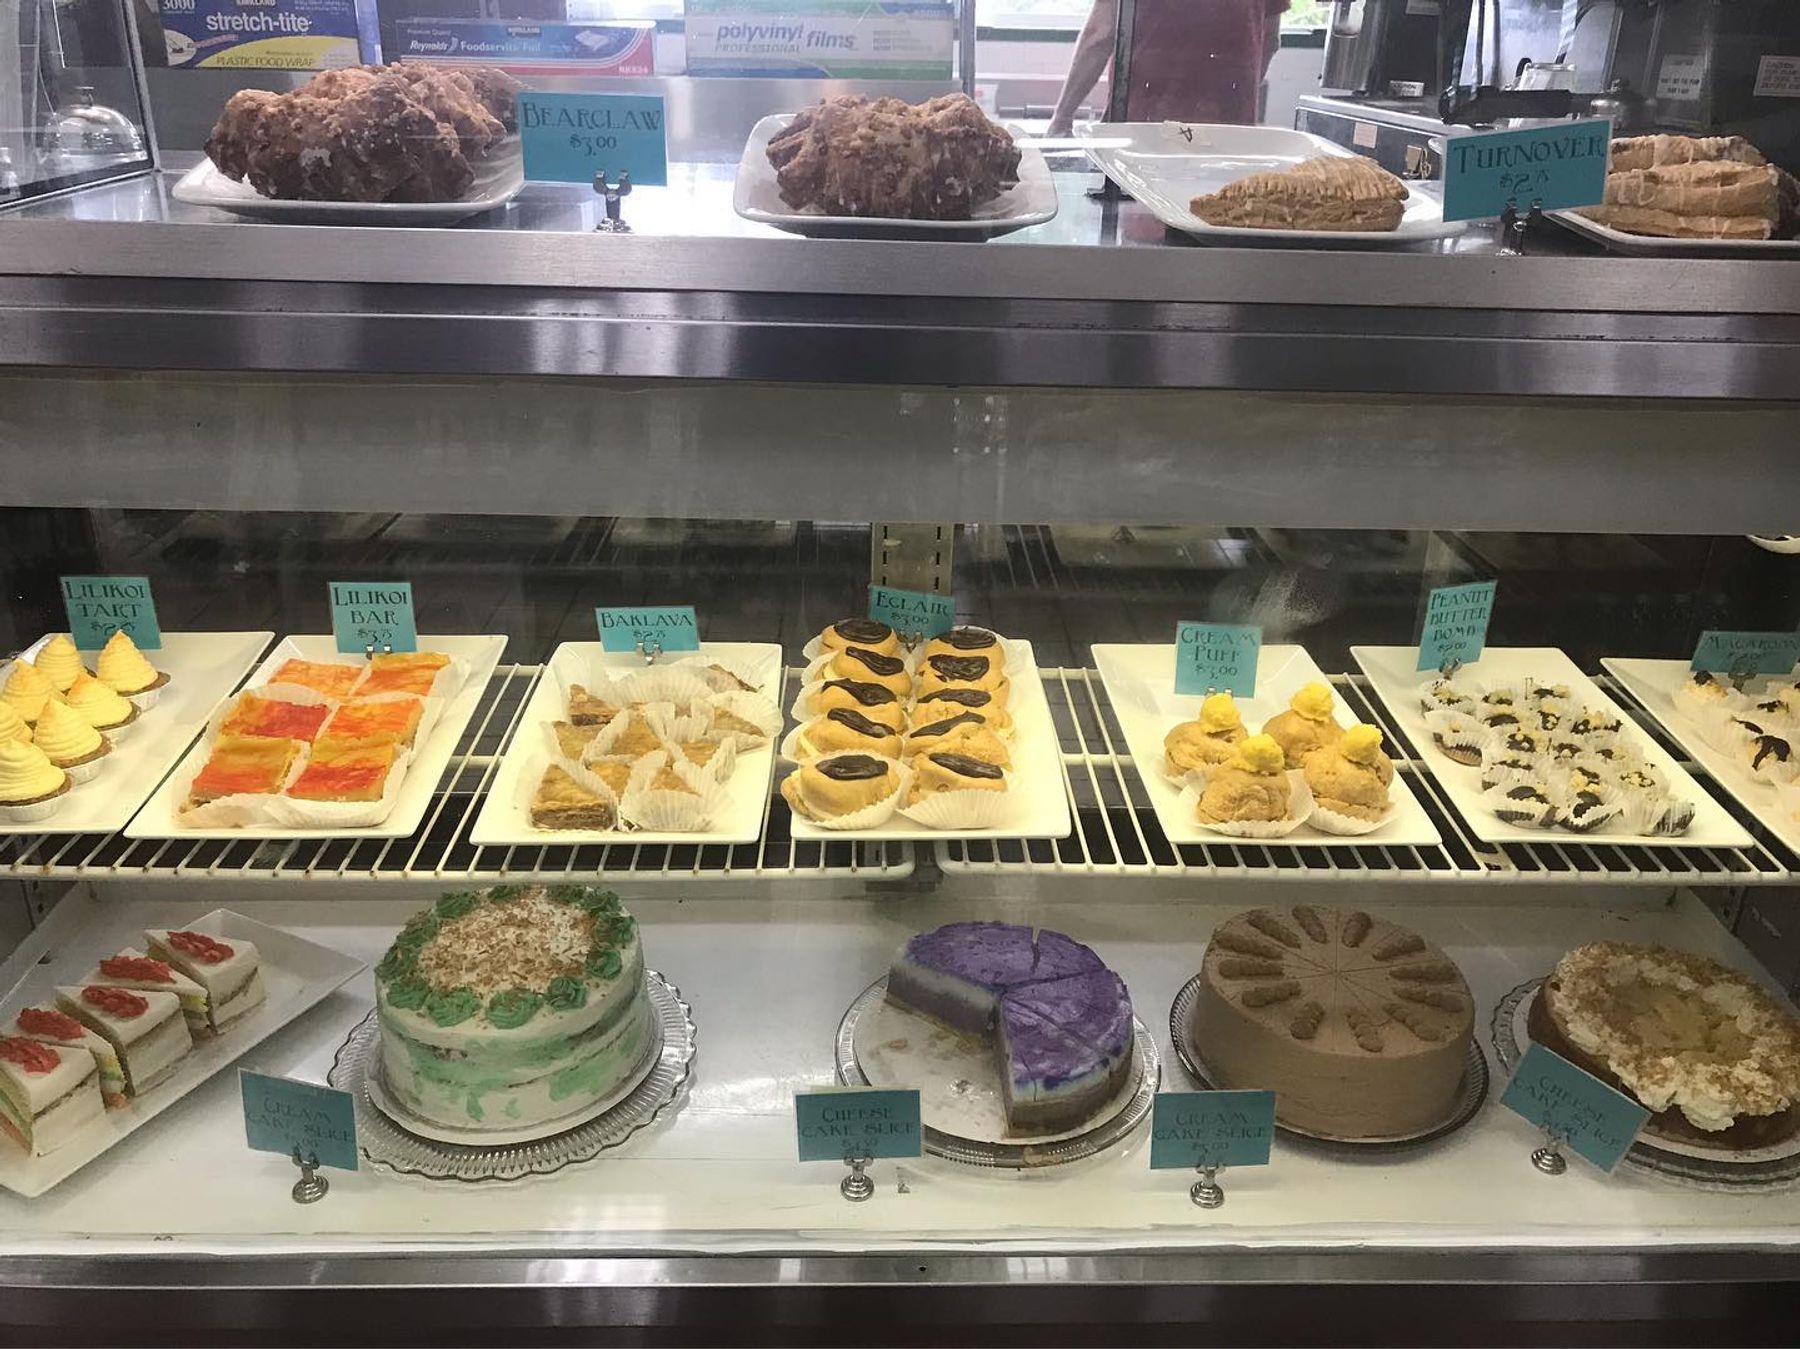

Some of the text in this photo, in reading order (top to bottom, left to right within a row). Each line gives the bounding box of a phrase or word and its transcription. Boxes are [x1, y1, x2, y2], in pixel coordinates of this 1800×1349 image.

[206, 11, 310, 33] stretch-tite
[716, 22, 804, 43] polyvinyl
[805, 30, 857, 50] films
[216, 57, 314, 67] PLASTIC FOOD WRAP
[521, 101, 661, 130] BEARCLAW
[569, 132, 617, 156] $3.00
[1453, 134, 1605, 174] TURNOVER
[64, 581, 145, 600] LILIKOI
[333, 586, 408, 607] LILIKOI
[75, 603, 142, 619] TART
[876, 590, 949, 617] ECLAIR
[350, 610, 399, 626] BAR
[600, 611, 693, 629] BAKLAVA
[1429, 607, 1487, 626] BUTTER
[1181, 627, 1256, 647] CREAM
[1194, 645, 1240, 662] PUFF
